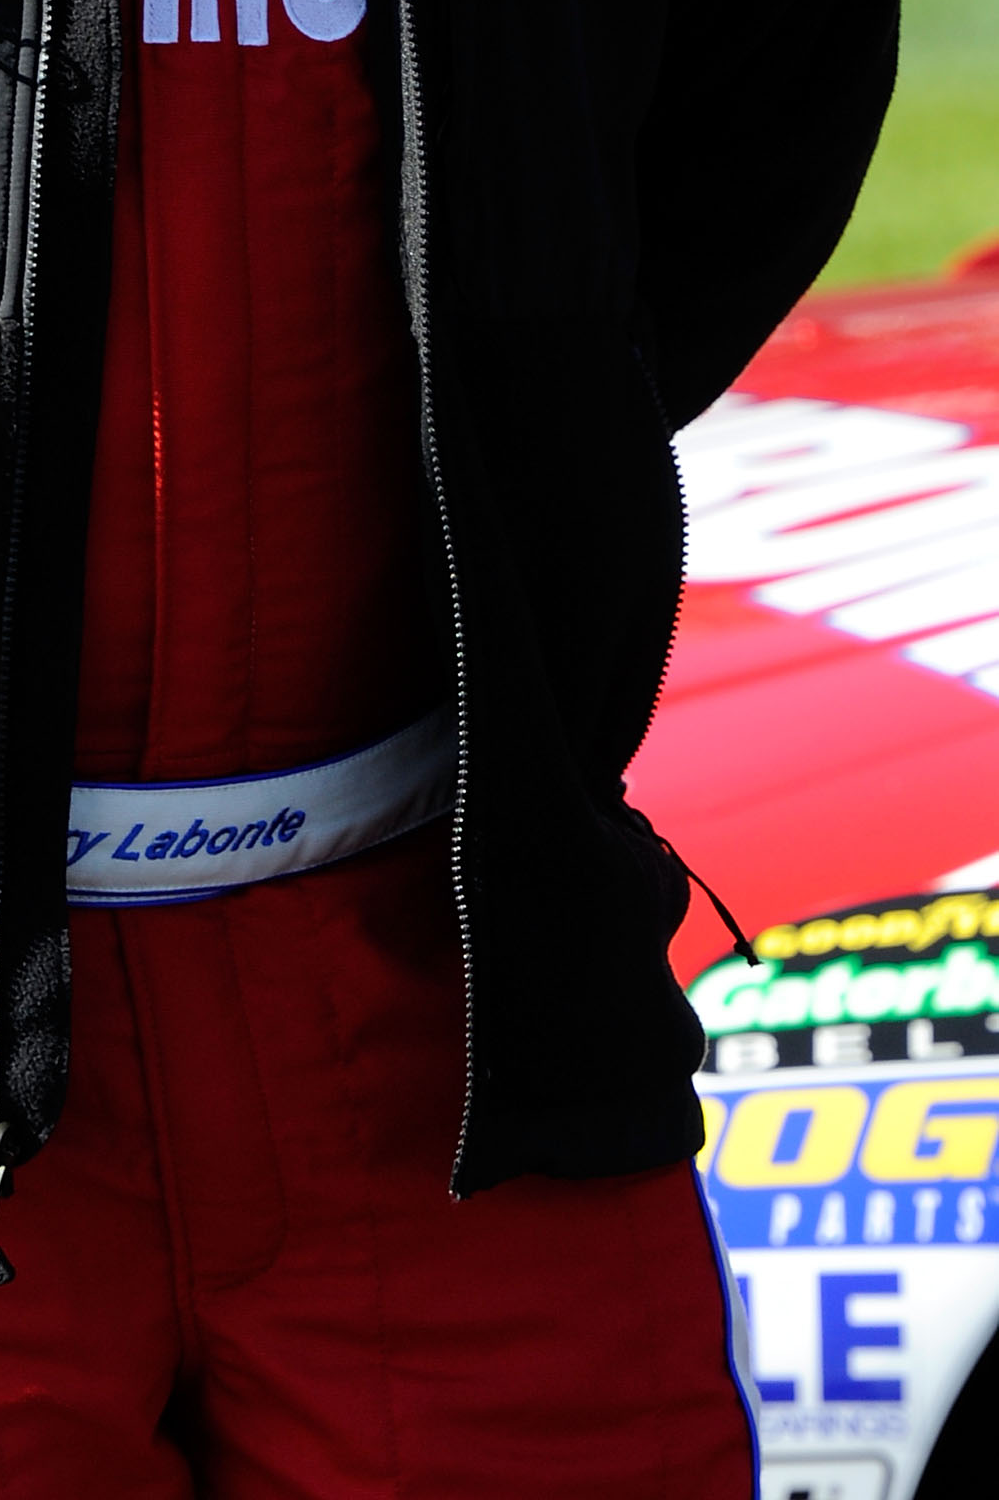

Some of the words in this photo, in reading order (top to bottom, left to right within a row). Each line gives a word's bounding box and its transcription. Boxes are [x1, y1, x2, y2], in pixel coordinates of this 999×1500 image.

[111, 806, 306, 862] Labonte
[687, 943, 999, 1036] Gatorb
[695, 1077, 999, 1190] OG
[768, 1187, 986, 1246] PARTS
